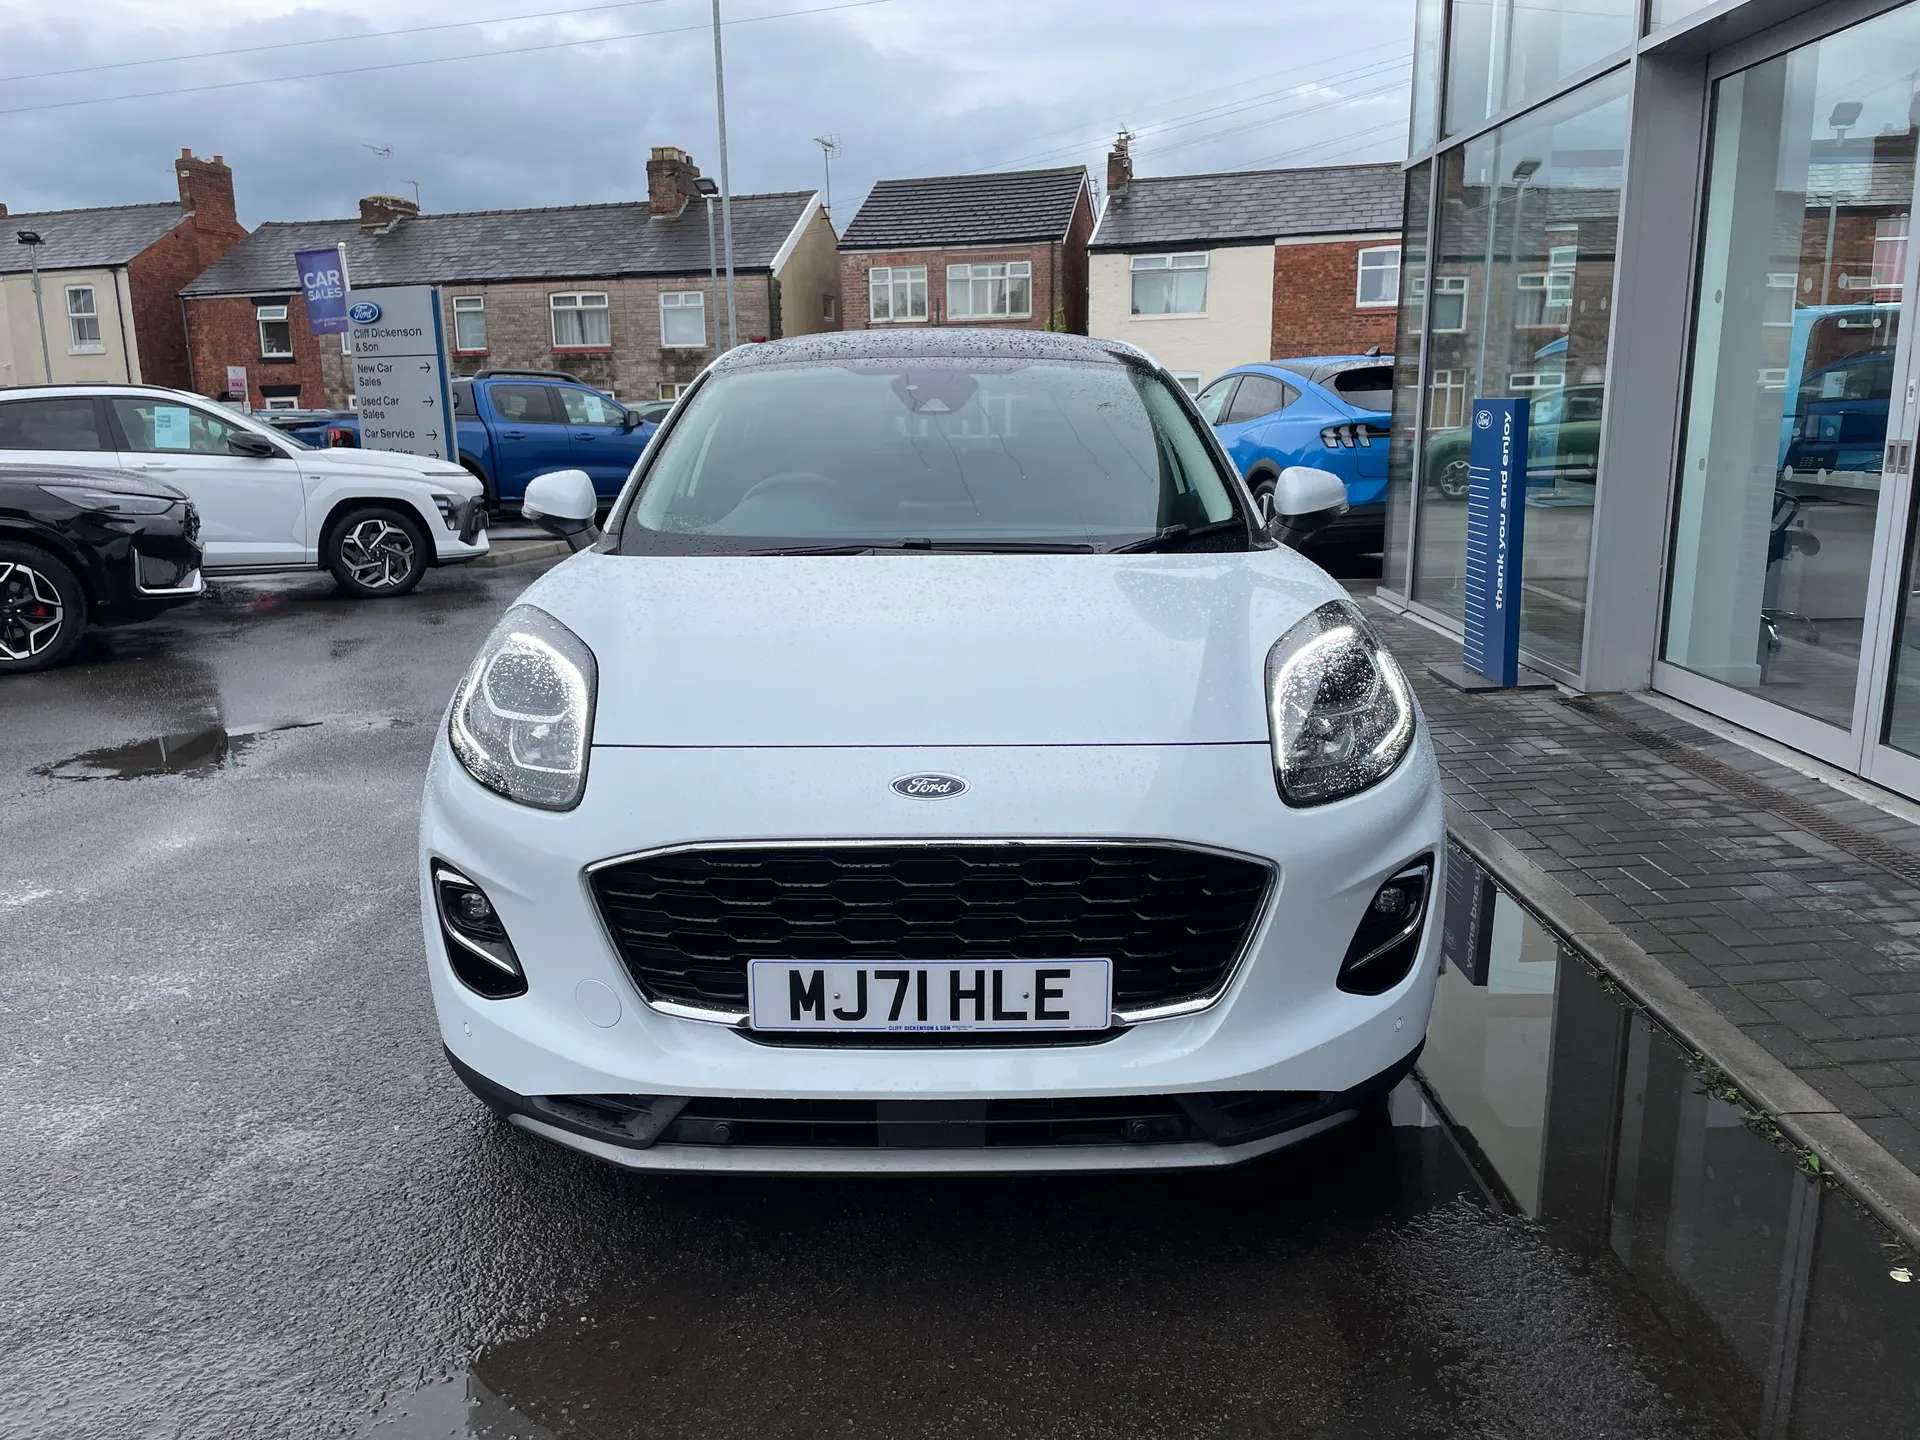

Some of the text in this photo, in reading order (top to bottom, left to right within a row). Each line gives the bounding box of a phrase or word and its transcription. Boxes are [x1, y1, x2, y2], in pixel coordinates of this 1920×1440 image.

[304, 269, 340, 289] CAR
[307, 287, 343, 301] SALES
[353, 306, 373, 319] Ford
[353, 327, 422, 339] Cliff Dickenson
[355, 341, 379, 352] & Son
[357, 362, 393, 374] New Car
[359, 376, 382, 387] Sales
[361, 395, 400, 406] Used Car
[363, 408, 385, 420] Sales
[364, 428, 415, 438] Car Service
[1495, 411, 1512, 610] thank you and enjoy
[907, 777, 951, 793] Ford
[788, 969, 1071, 1022] MJ71 HLE
